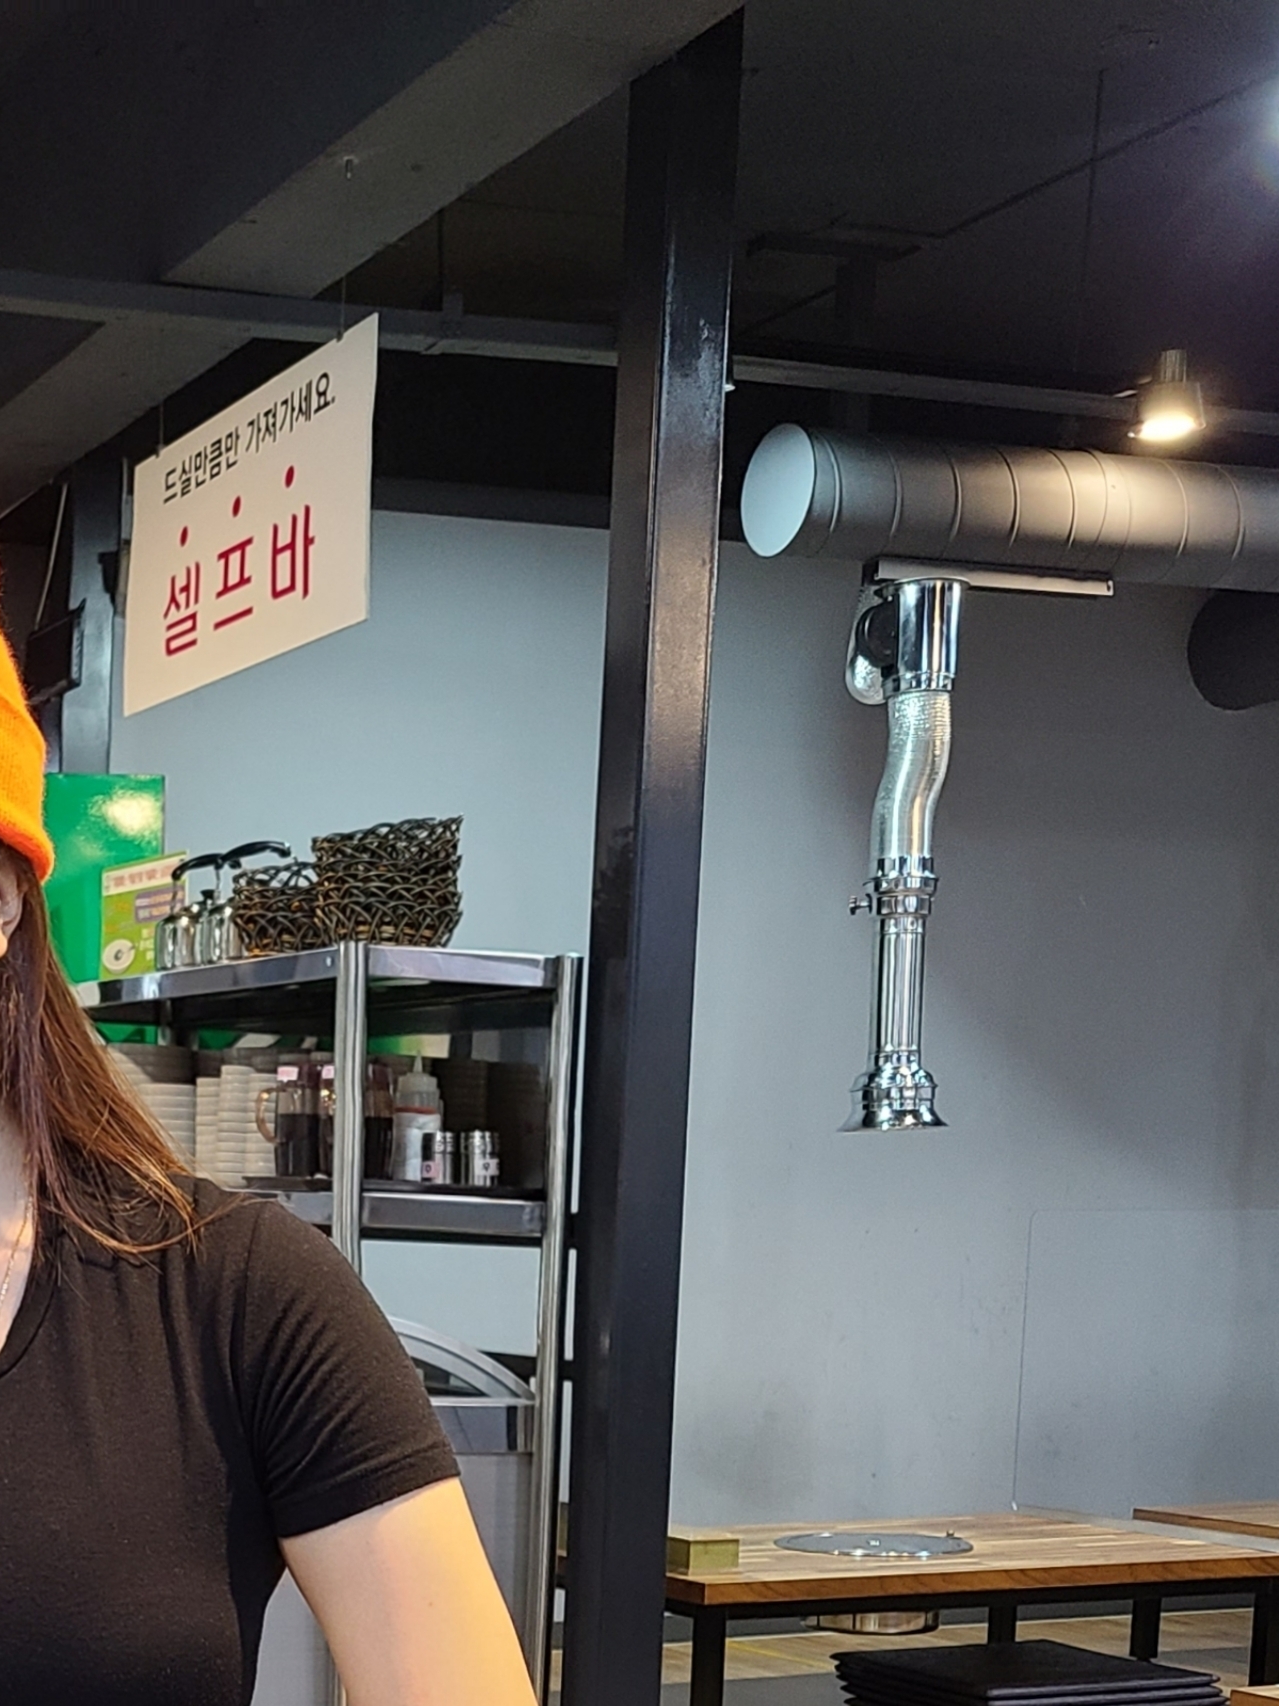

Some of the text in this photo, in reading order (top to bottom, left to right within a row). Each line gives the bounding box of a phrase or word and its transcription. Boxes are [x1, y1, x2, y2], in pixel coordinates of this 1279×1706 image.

[163, 371, 337, 505] 드실만큼만 가져가세요.
[163, 504, 316, 657] 셀프바
